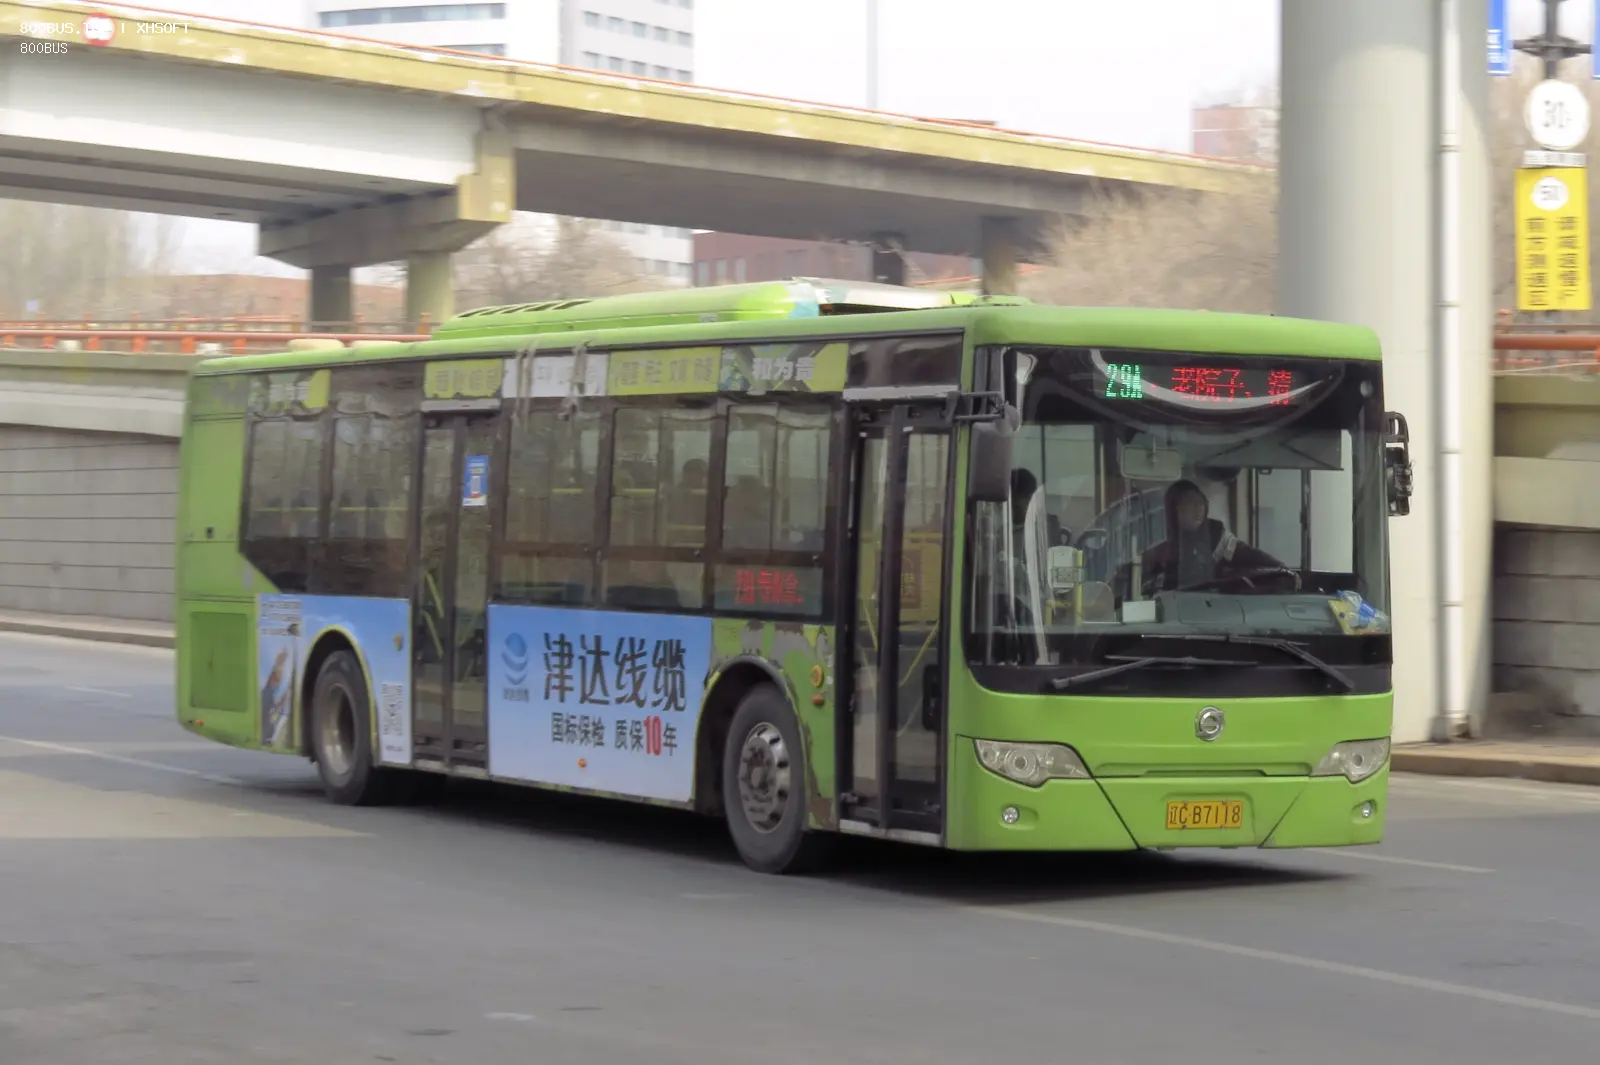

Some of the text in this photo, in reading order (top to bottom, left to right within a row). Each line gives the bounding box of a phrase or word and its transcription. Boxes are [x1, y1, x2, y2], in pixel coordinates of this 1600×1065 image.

[543, 632, 687, 712] 津达线缆
[614, 715, 678, 756] 质保10年
